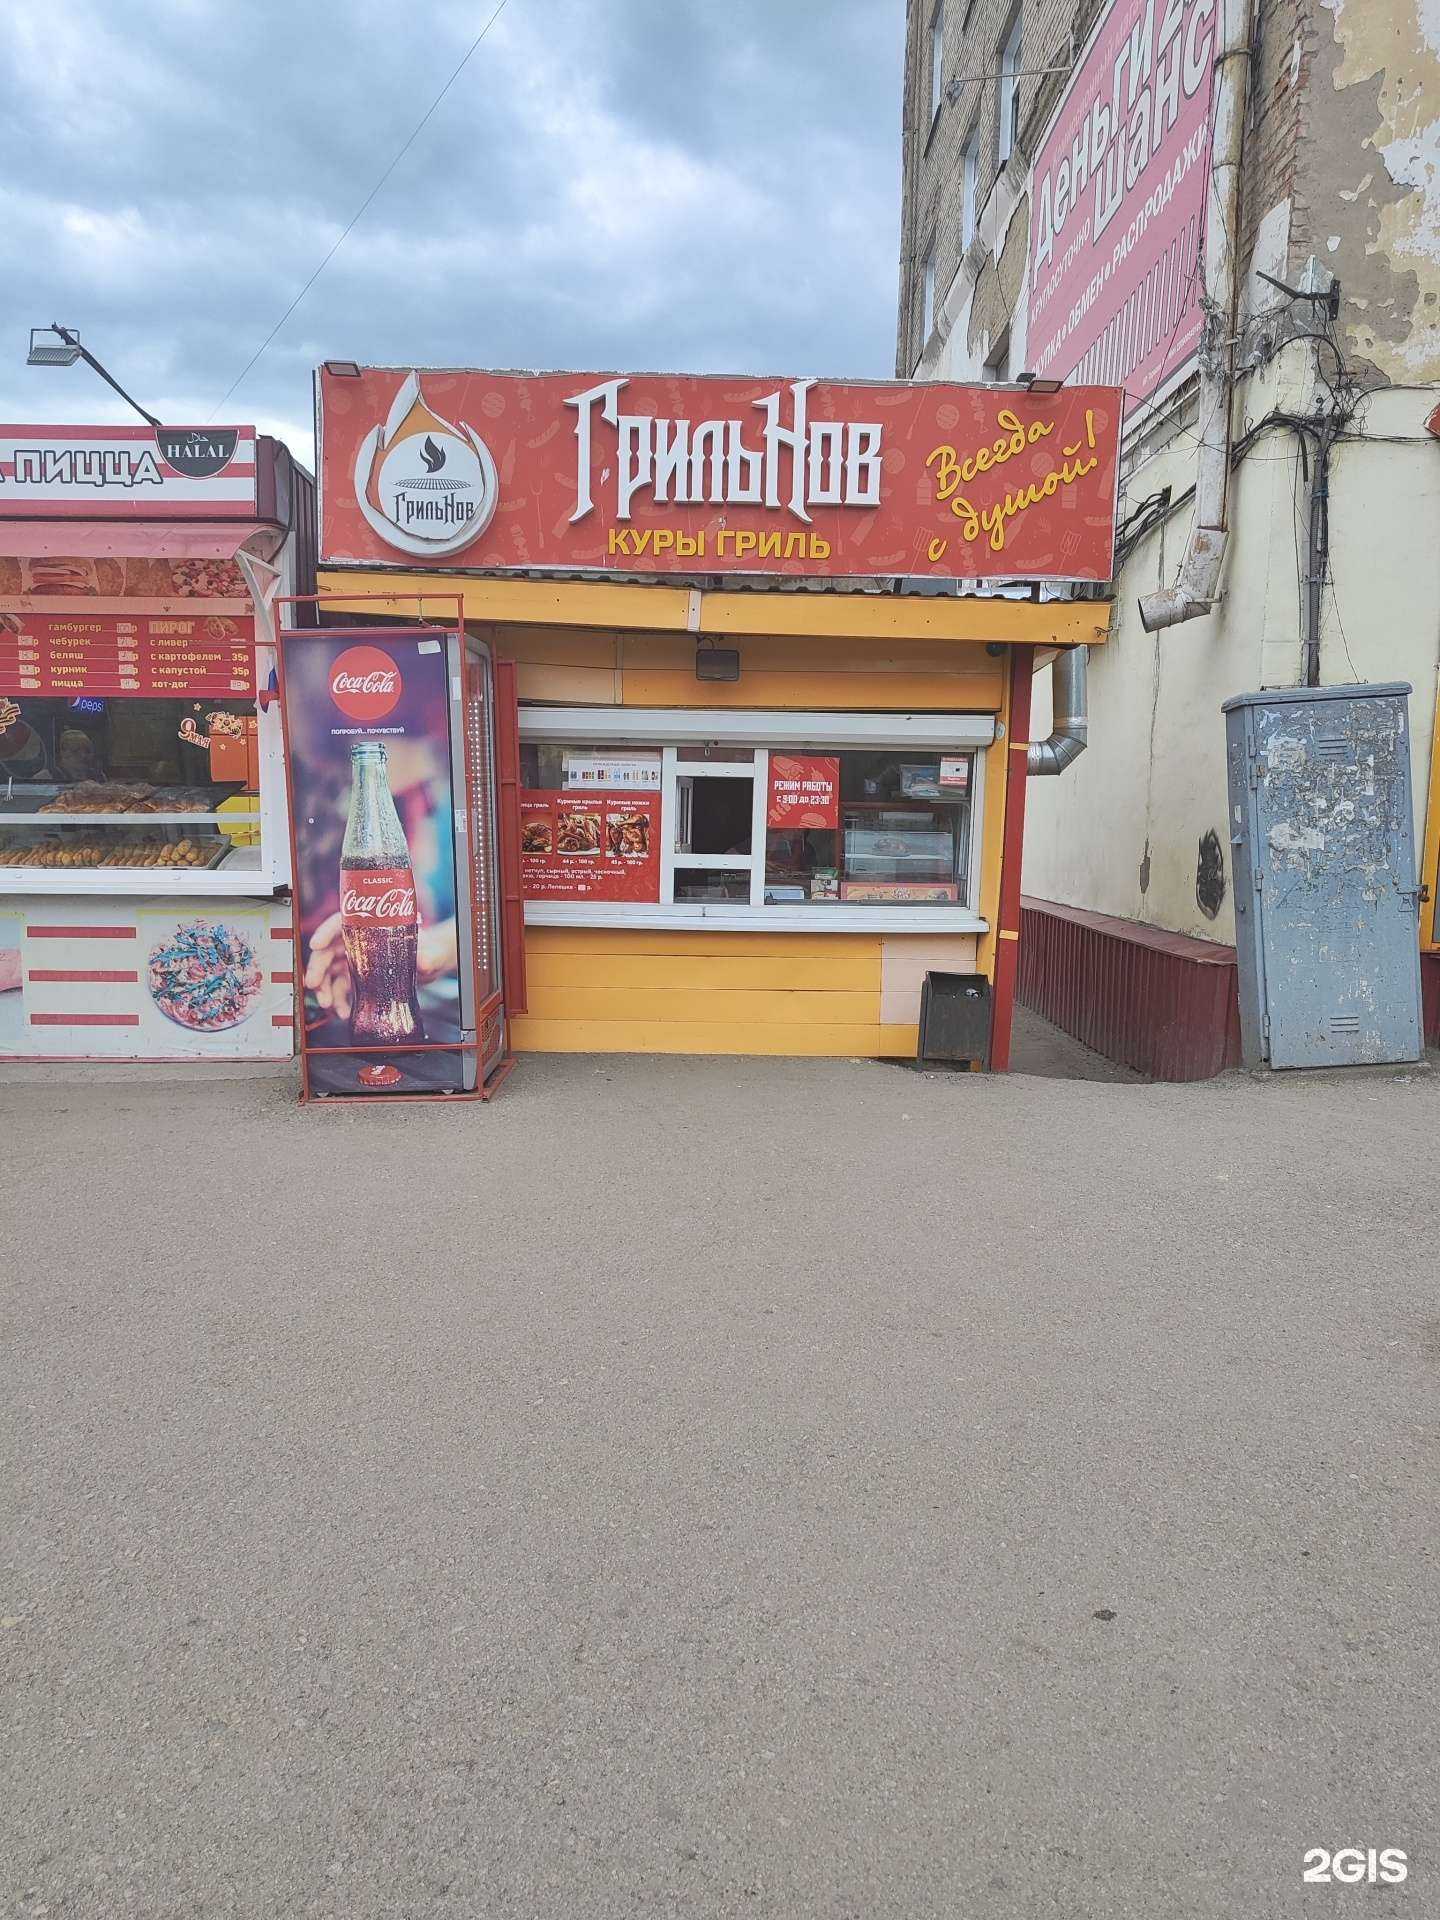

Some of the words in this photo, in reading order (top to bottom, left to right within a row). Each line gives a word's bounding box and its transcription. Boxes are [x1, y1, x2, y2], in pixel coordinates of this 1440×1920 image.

[1068, 265, 1104, 334] ОБМЕН
[1112, 115, 1209, 275] РАСПРОДАЖИ
[1031, 217, 1091, 328] КРУГЛОСУТОЧНО
[167, 444, 230, 458] HALAL
[925, 409, 1055, 500] Всегда
[14, 449, 164, 487] ПИЦЦА
[608, 528, 705, 556] КУРЫ
[716, 529, 831, 559] ГРИЛЬ
[48, 623, 102, 633] гамбургер
[148, 620, 195, 634] ПИРОГ
[49, 637, 92, 646] чебурек
[50, 650, 84, 660] беляш
[158, 652, 222, 662] картофелем
[231, 652, 249, 662] 35р
[50, 665, 88, 674] курник
[159, 665, 207, 675] капустой
[232, 667, 250, 676] 35р
[51, 680, 84, 688] пицца
[151, 680, 189, 689] хот-дог
[80, 698, 104, 712] pepsi
[774, 780, 801, 791] РЕЖИМ
[802, 781, 833, 792] РАБОТЫ
[362, 877, 394, 885] CLASSIC
